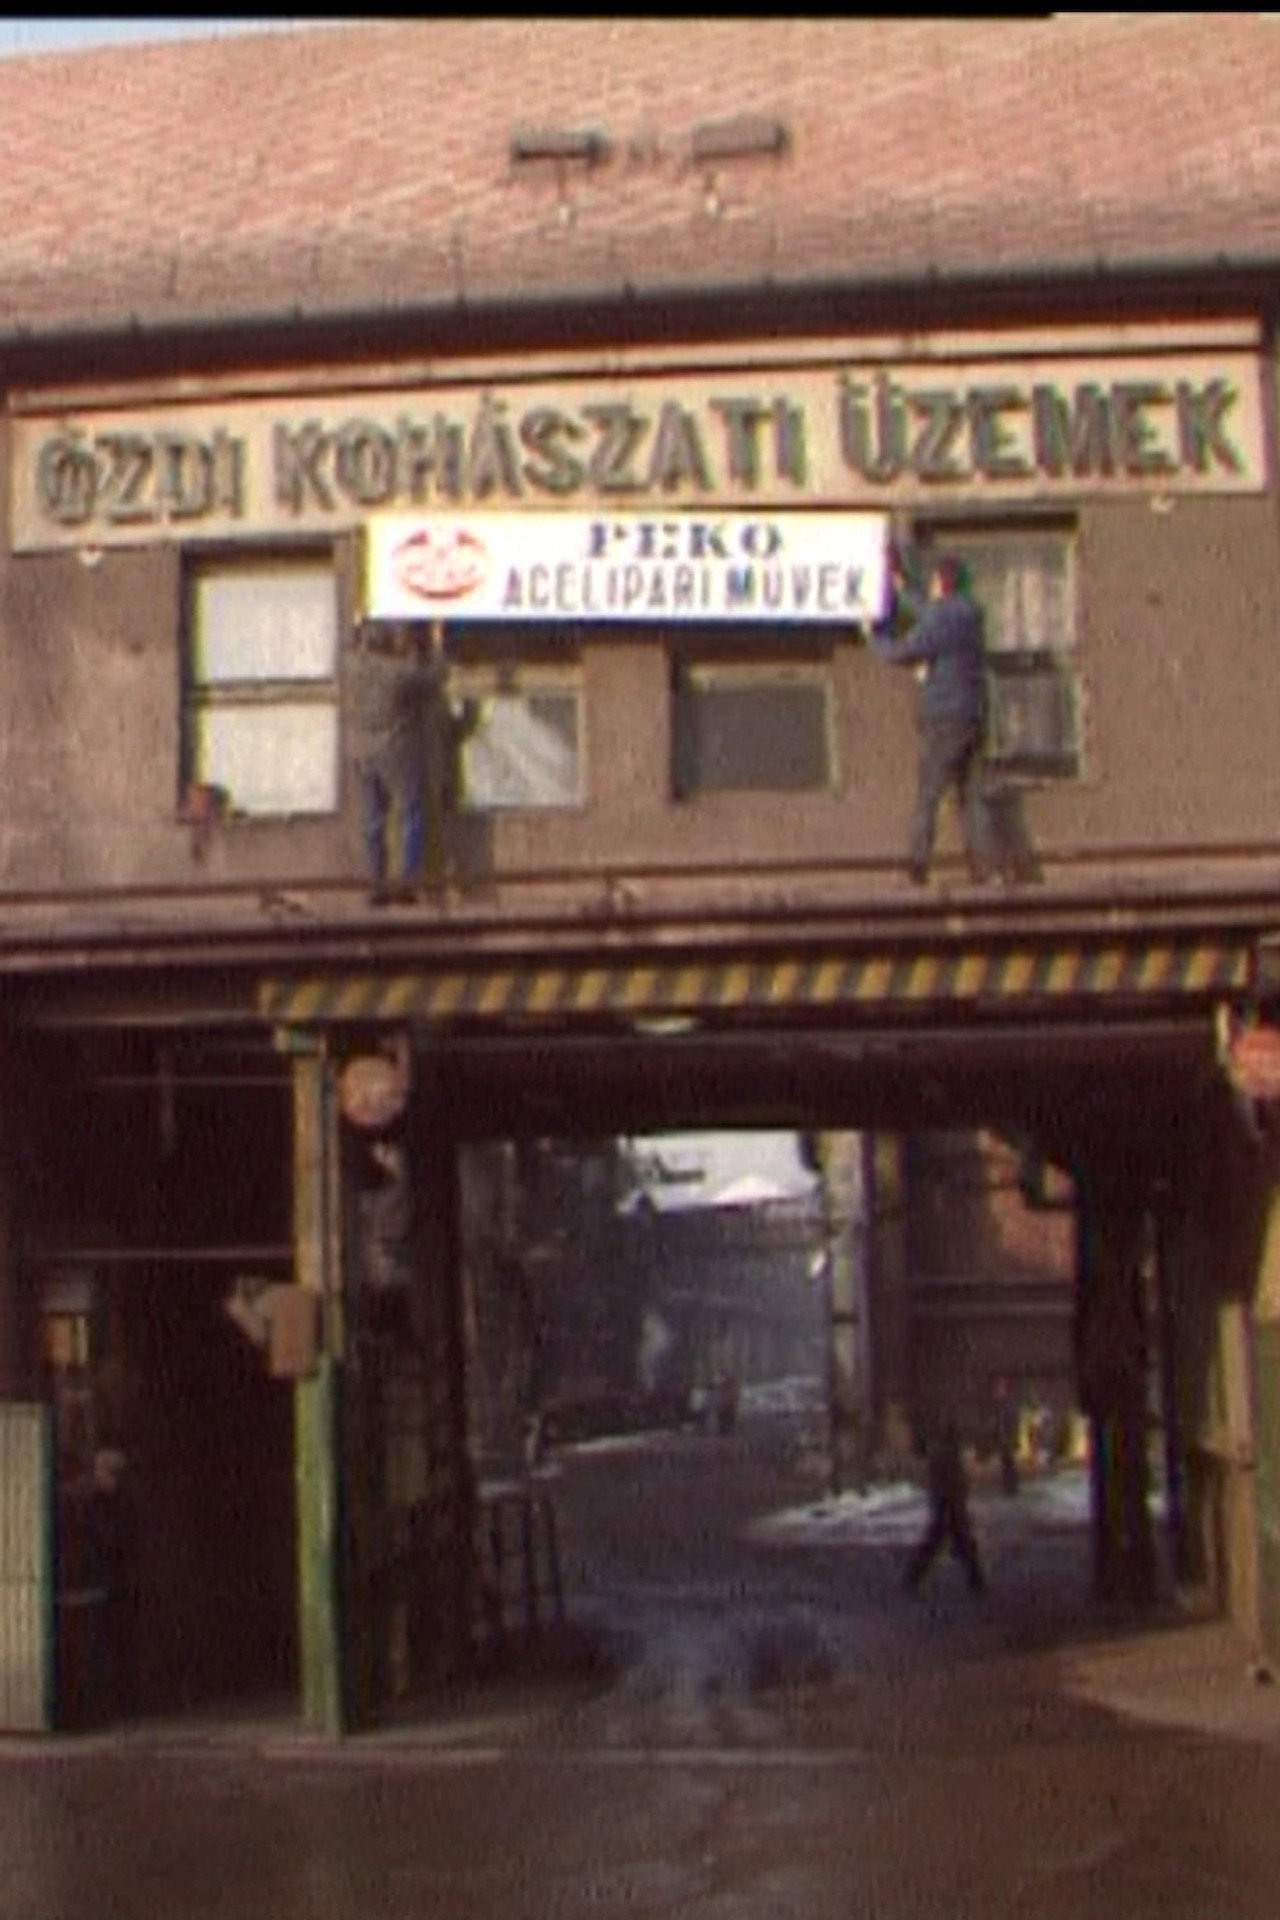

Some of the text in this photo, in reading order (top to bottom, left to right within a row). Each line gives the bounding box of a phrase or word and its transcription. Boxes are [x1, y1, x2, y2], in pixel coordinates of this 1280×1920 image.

[272, 389, 806, 515] KOHÁSZATI
[836, 366, 1246, 484] ÜZEMEK
[588, 521, 783, 560] PEKO
